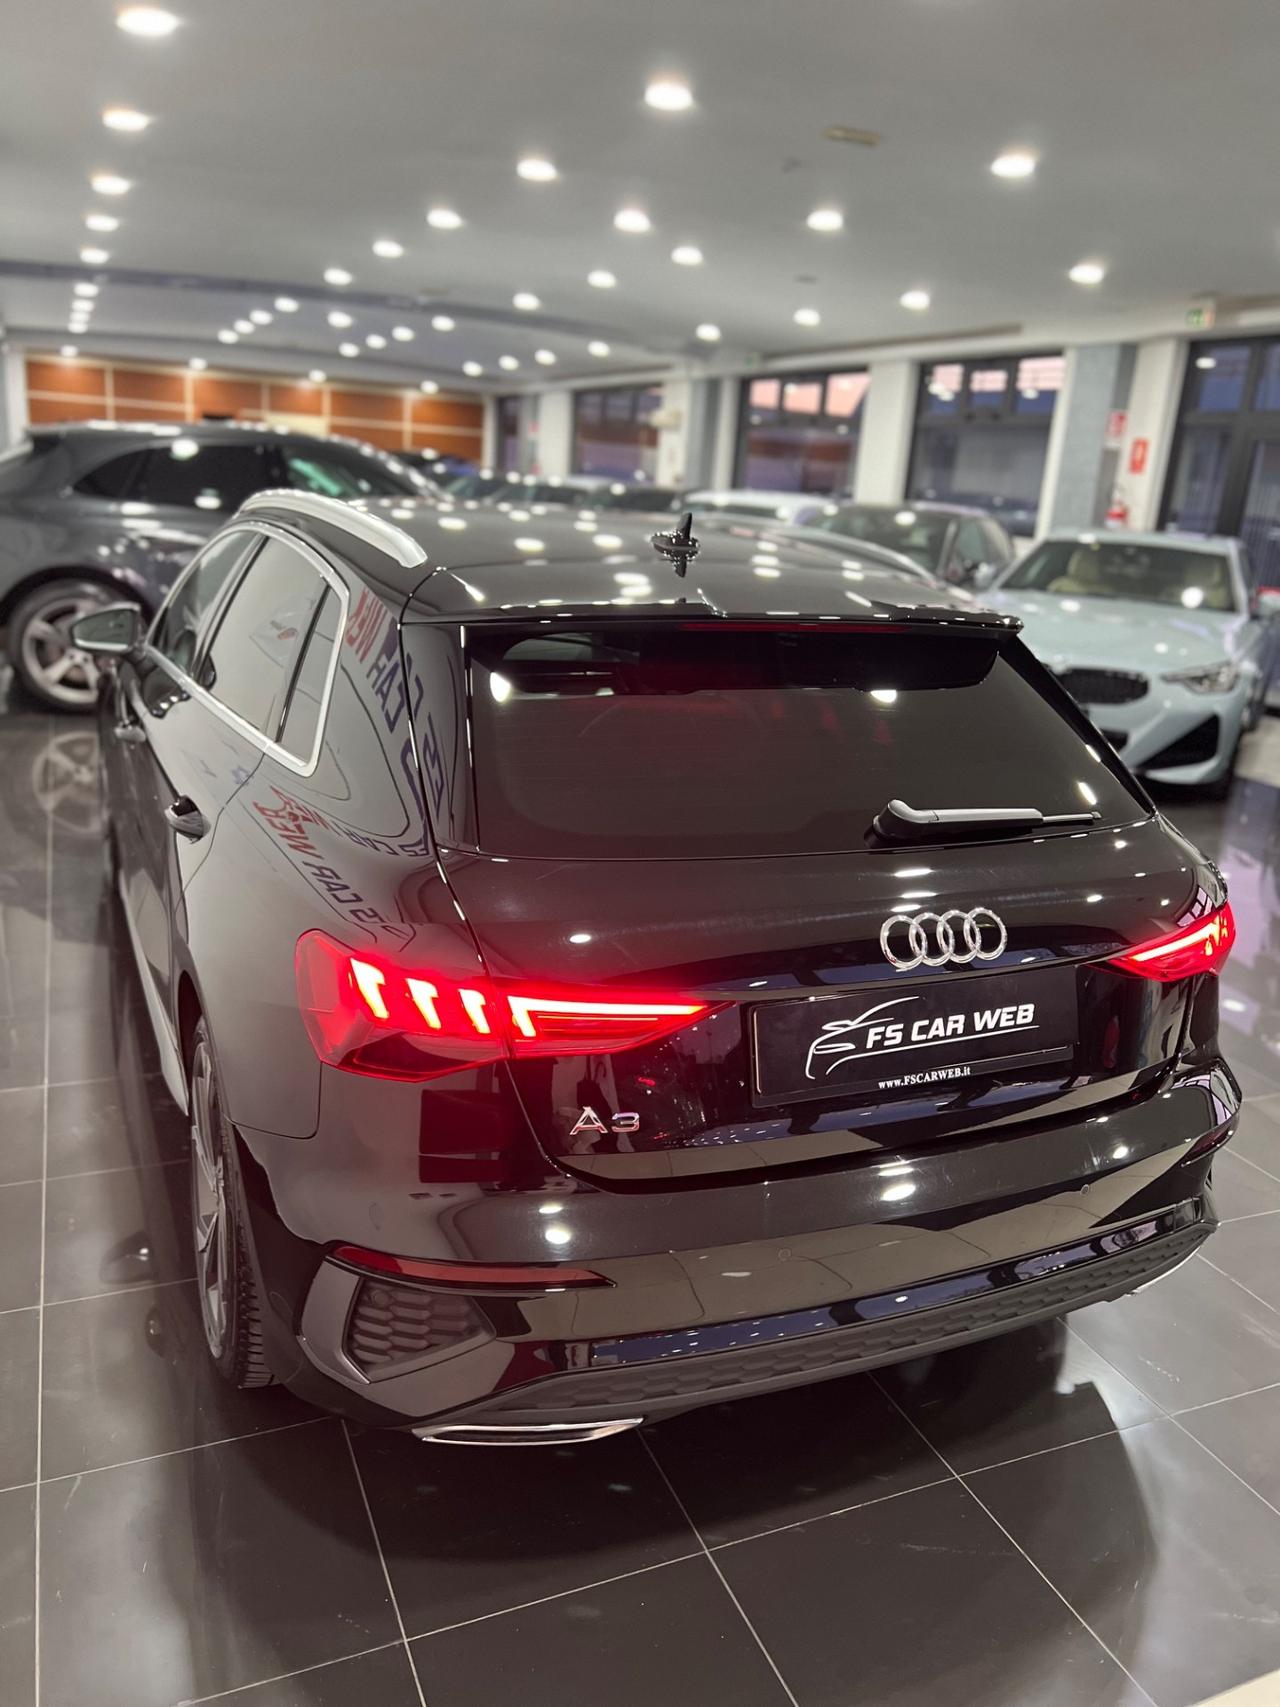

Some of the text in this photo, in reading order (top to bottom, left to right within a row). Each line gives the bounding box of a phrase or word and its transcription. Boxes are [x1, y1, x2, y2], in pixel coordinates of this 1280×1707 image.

[865, 1003, 1035, 1049] FS CAR WEB
[878, 1066, 971, 1089] www.FSCARWEB.it
[569, 1106, 640, 1135] A3
